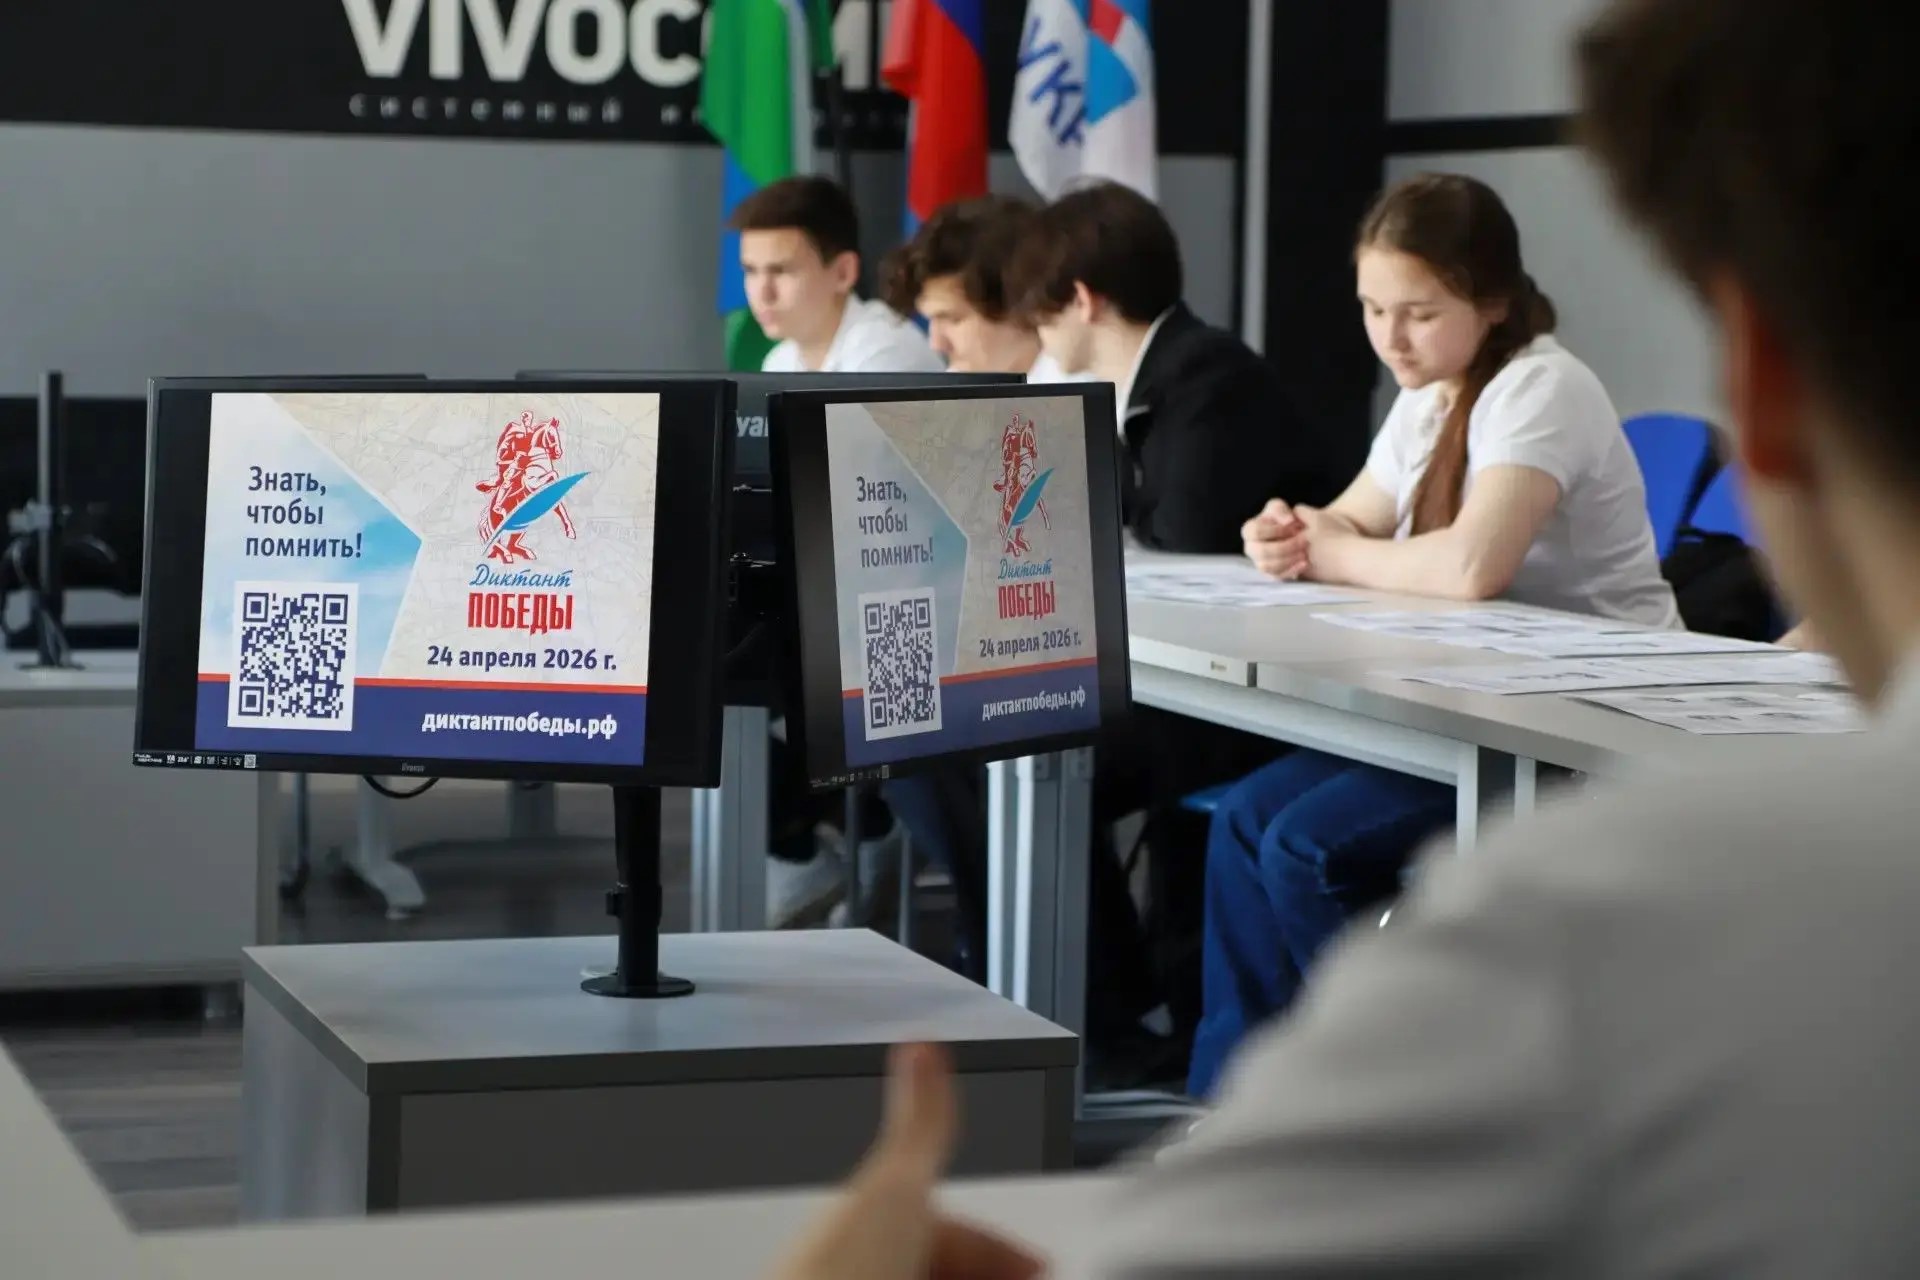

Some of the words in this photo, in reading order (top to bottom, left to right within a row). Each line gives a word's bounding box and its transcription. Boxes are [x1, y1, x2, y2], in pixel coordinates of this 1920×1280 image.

[248, 465, 327, 496] Знать,
[855, 475, 908, 503] Знать,
[246, 498, 324, 525] чтобы
[858, 506, 908, 535] чтобы
[245, 532, 363, 559] помнить!
[860, 536, 934, 569] помнить!
[468, 563, 574, 589] Диктант
[997, 557, 1054, 582] Диктант
[467, 592, 574, 636] ПОБЕДЫ
[998, 580, 1056, 621] ПОБЕДЫ
[979, 638, 995, 658] 24
[997, 634, 1040, 660] апреля
[1042, 627, 1072, 651] 2026
[1073, 630, 1083, 647] г.
[427, 645, 454, 667] 24
[458, 650, 537, 673] апреля
[543, 648, 598, 670] 2026
[602, 654, 618, 671] г.
[981, 684, 1086, 722] диктантпобеды.рф
[421, 711, 618, 740] диктантпобеды.рф
